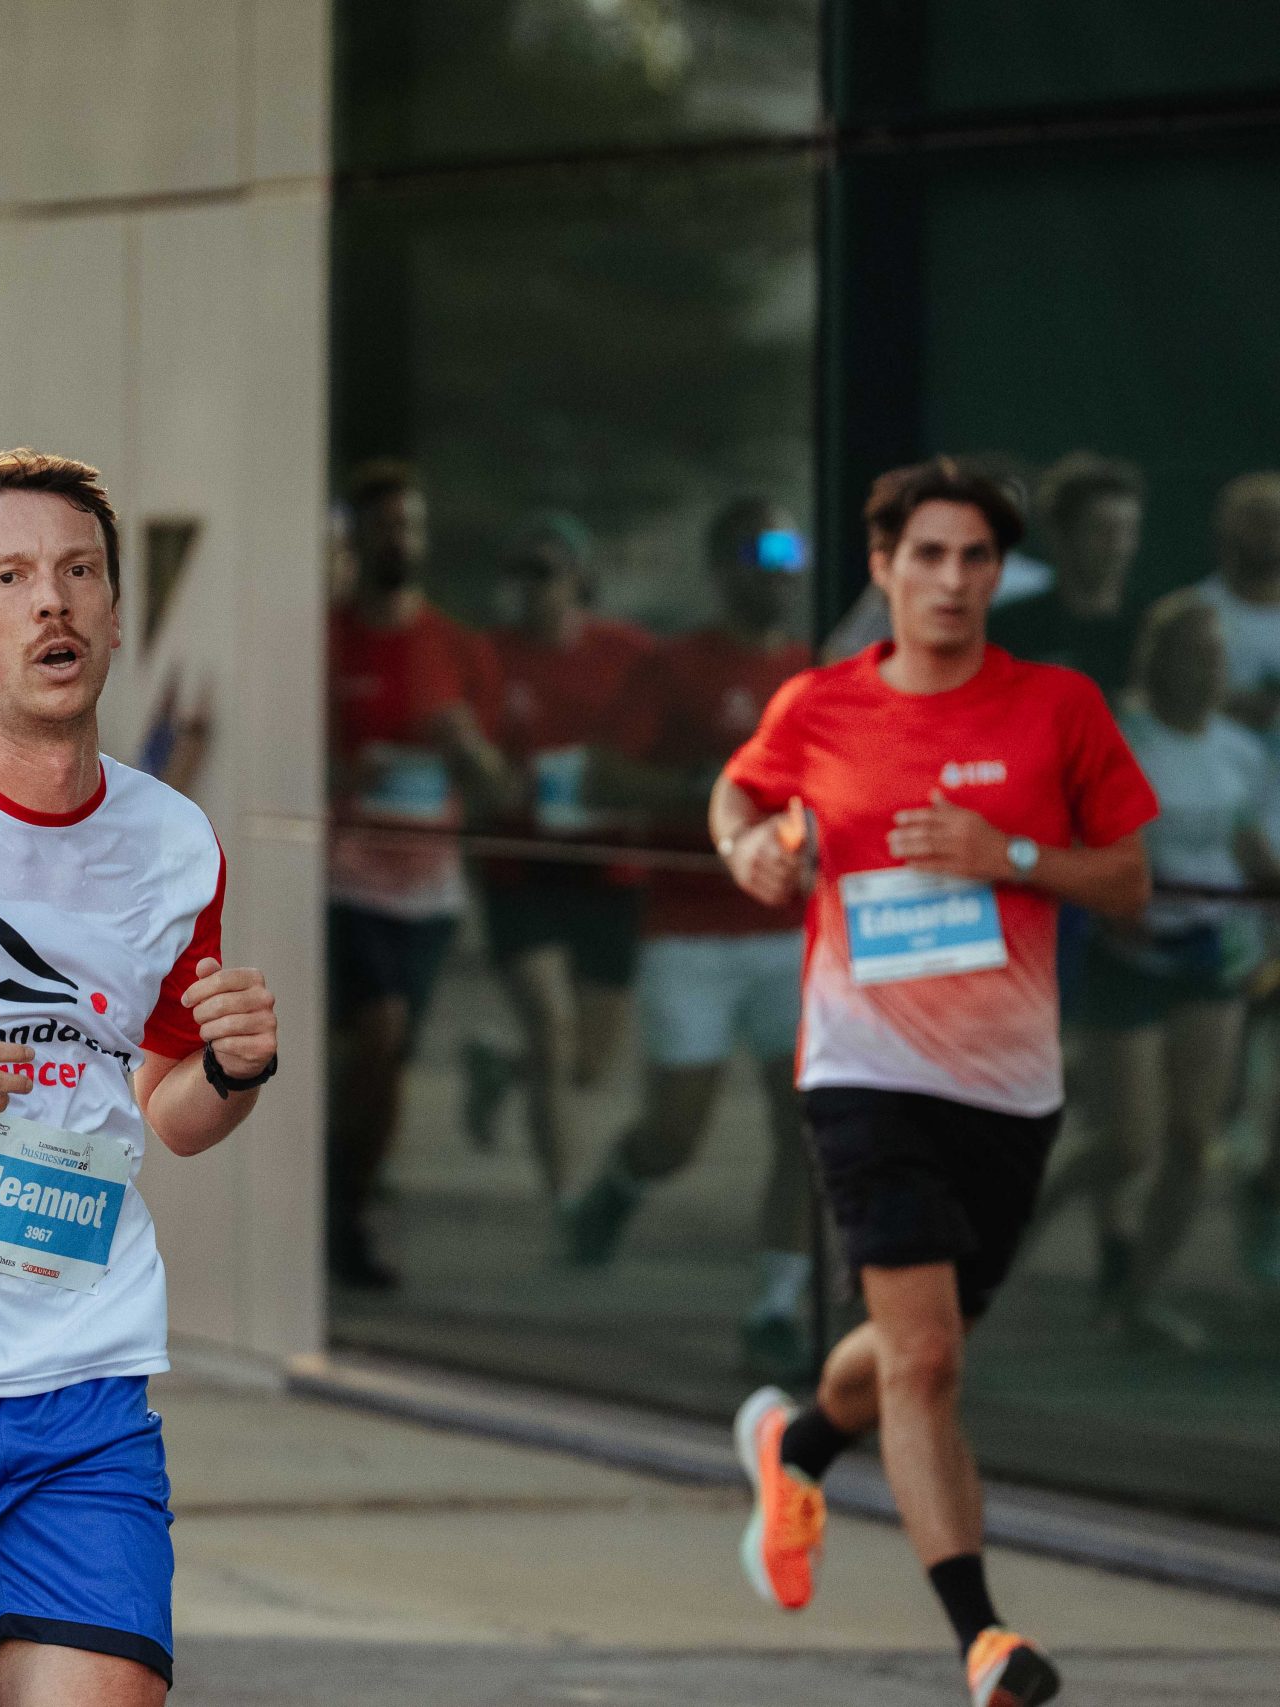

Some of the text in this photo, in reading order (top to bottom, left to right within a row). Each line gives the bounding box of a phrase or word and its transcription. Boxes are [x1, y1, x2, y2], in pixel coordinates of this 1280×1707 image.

[78, 1161, 88, 1171] 26
[24, 1225, 53, 1243] 3967
[28, 1265, 60, 1278] BAUHAUS
